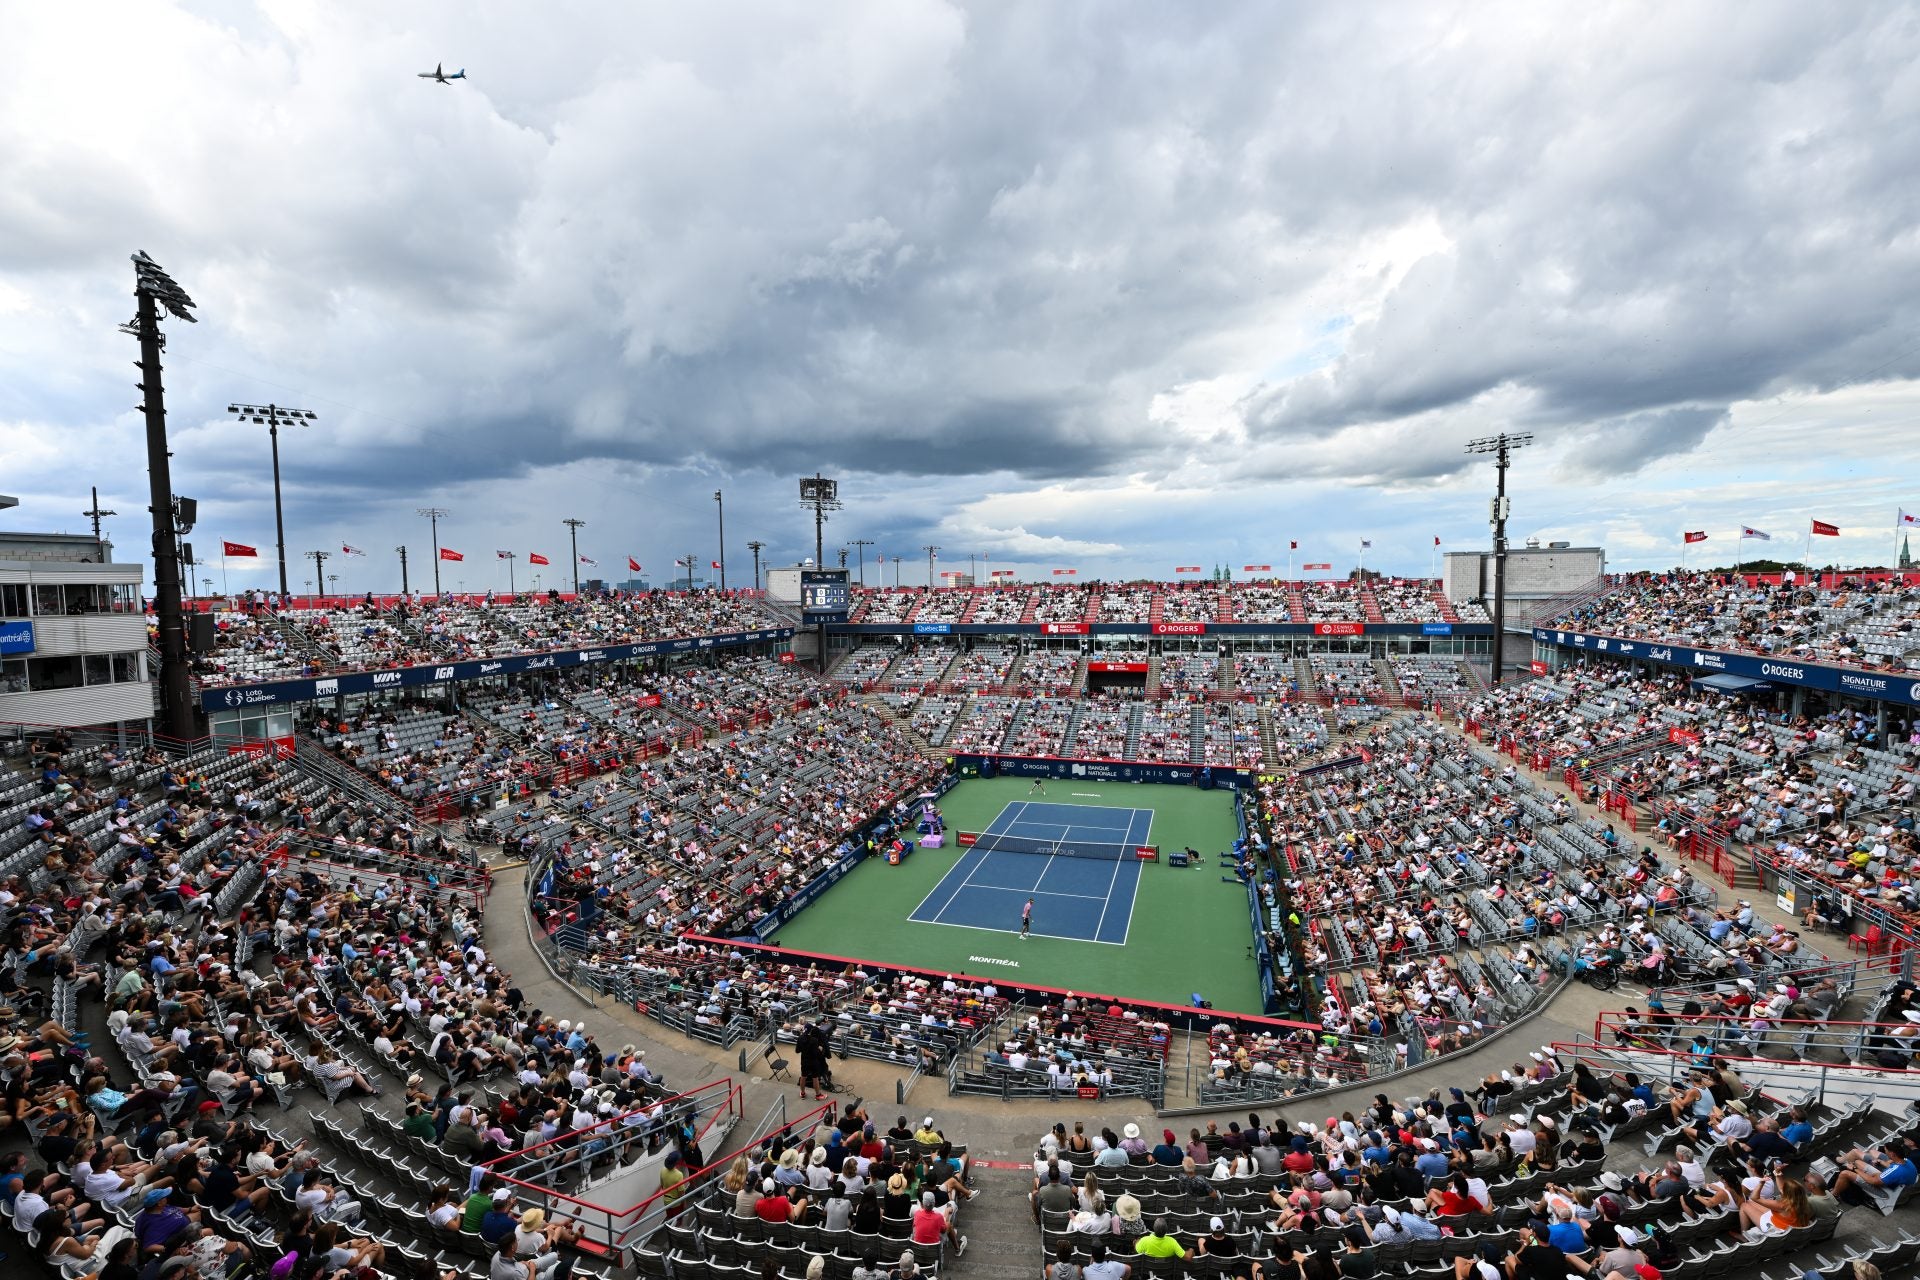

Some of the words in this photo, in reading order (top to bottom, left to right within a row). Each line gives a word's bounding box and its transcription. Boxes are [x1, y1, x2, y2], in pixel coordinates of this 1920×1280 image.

[0, 632, 22, 643] ontréal
[637, 645, 657, 653] ROGERS
[1648, 647, 1668, 660] Lindt
[526, 658, 549, 669] Lindt
[1705, 654, 1721, 662] BANQUE
[1705, 661, 1726, 669] NATIONALE
[435, 666, 455, 680] IGA
[1771, 665, 1804, 679] ROGERS
[374, 672, 395, 684] VIA
[1842, 675, 1888, 689] SIGNATURE
[316, 686, 339, 696] KIND
[246, 693, 276, 703] Québec
[1140, 769, 1163, 777] IRIS
[890, 854, 897, 863] G
[969, 955, 1021, 968] MONTRÉAL
